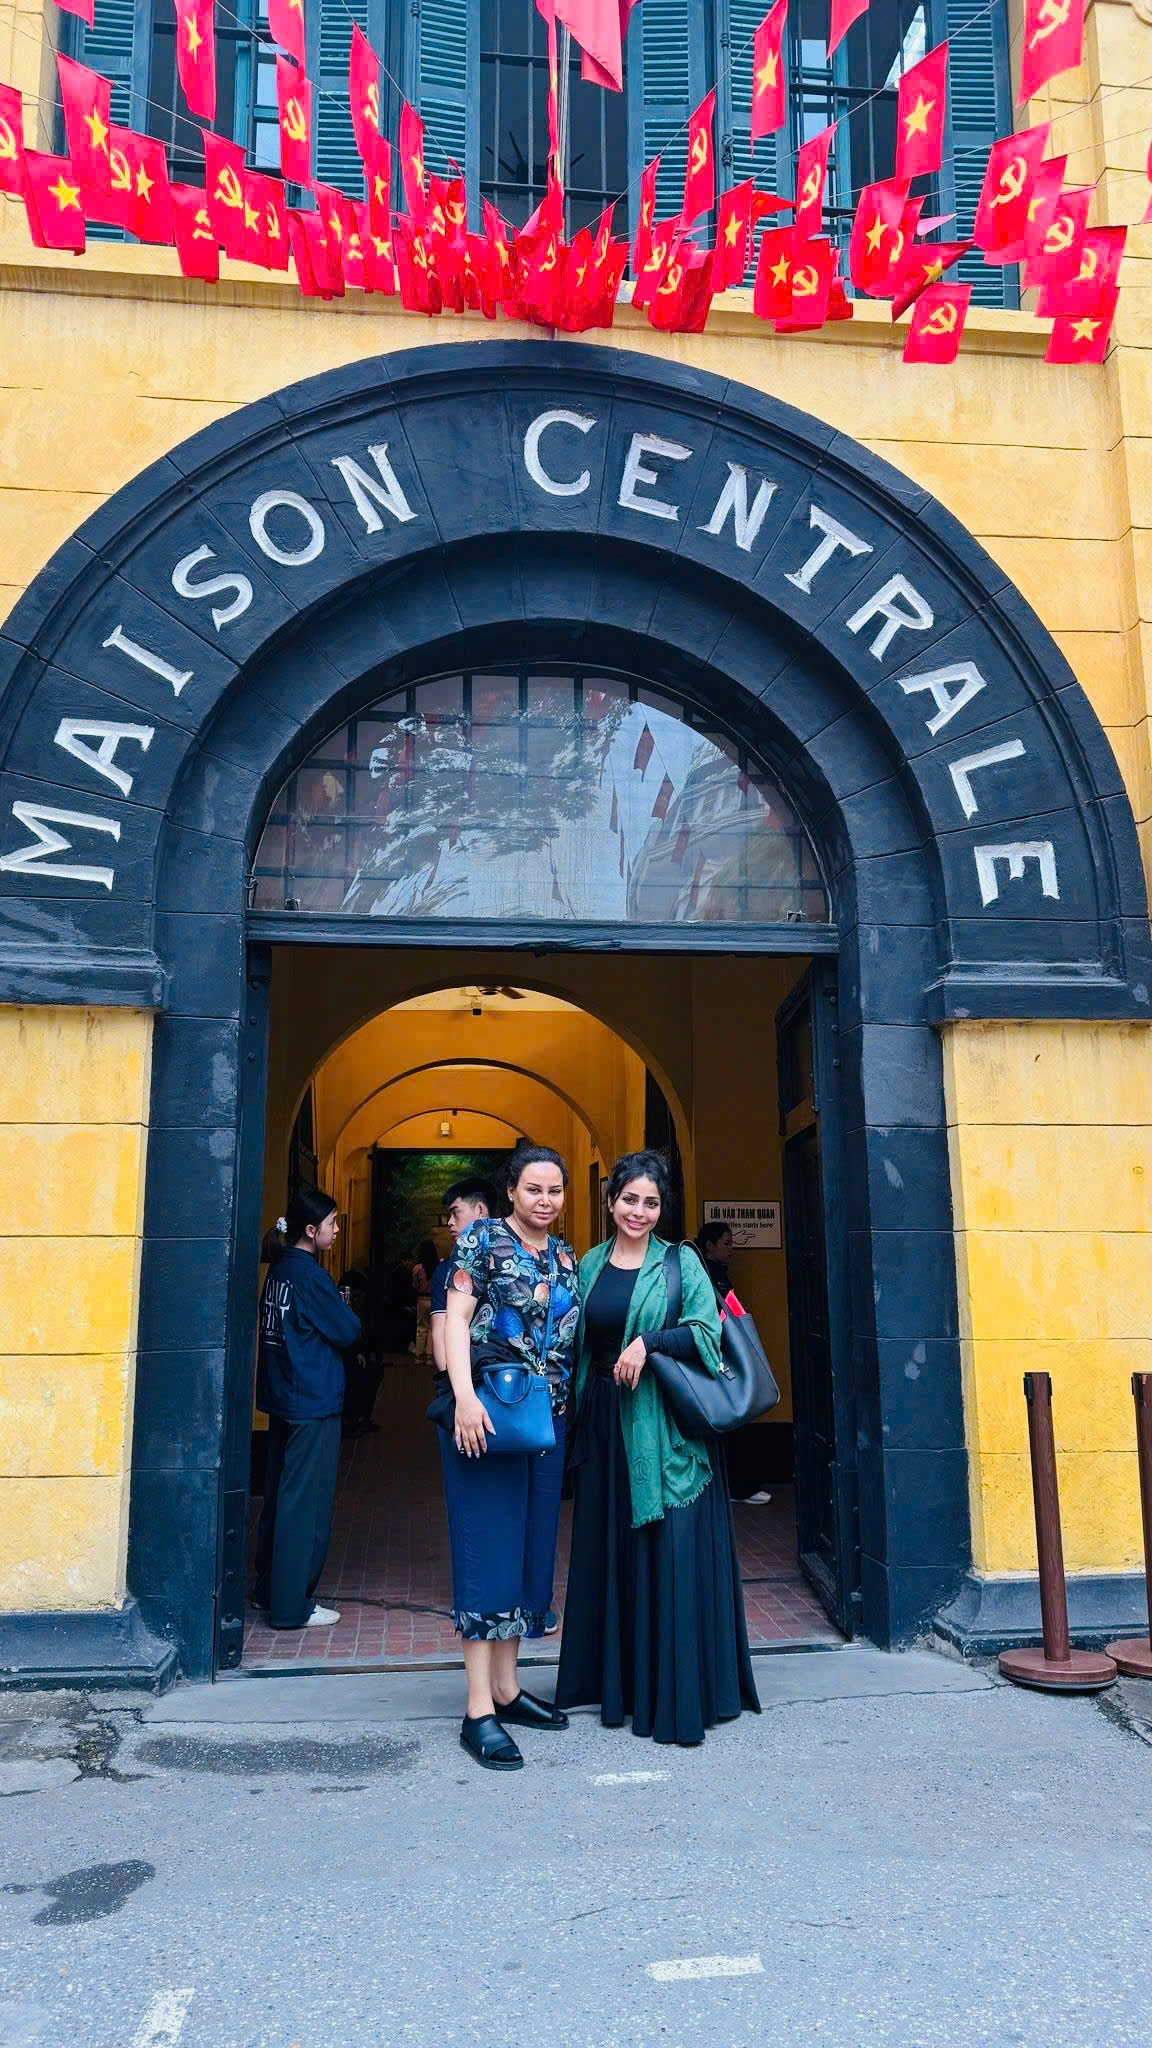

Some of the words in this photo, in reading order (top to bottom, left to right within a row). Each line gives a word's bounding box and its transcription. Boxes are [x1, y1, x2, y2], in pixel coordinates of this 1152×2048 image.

[0, 441, 418, 892] MAISON
[523, 408, 1060, 907] CENTRALE
[738, 1208, 755, 1219] THAM
[757, 1208, 775, 1219] QUAN
